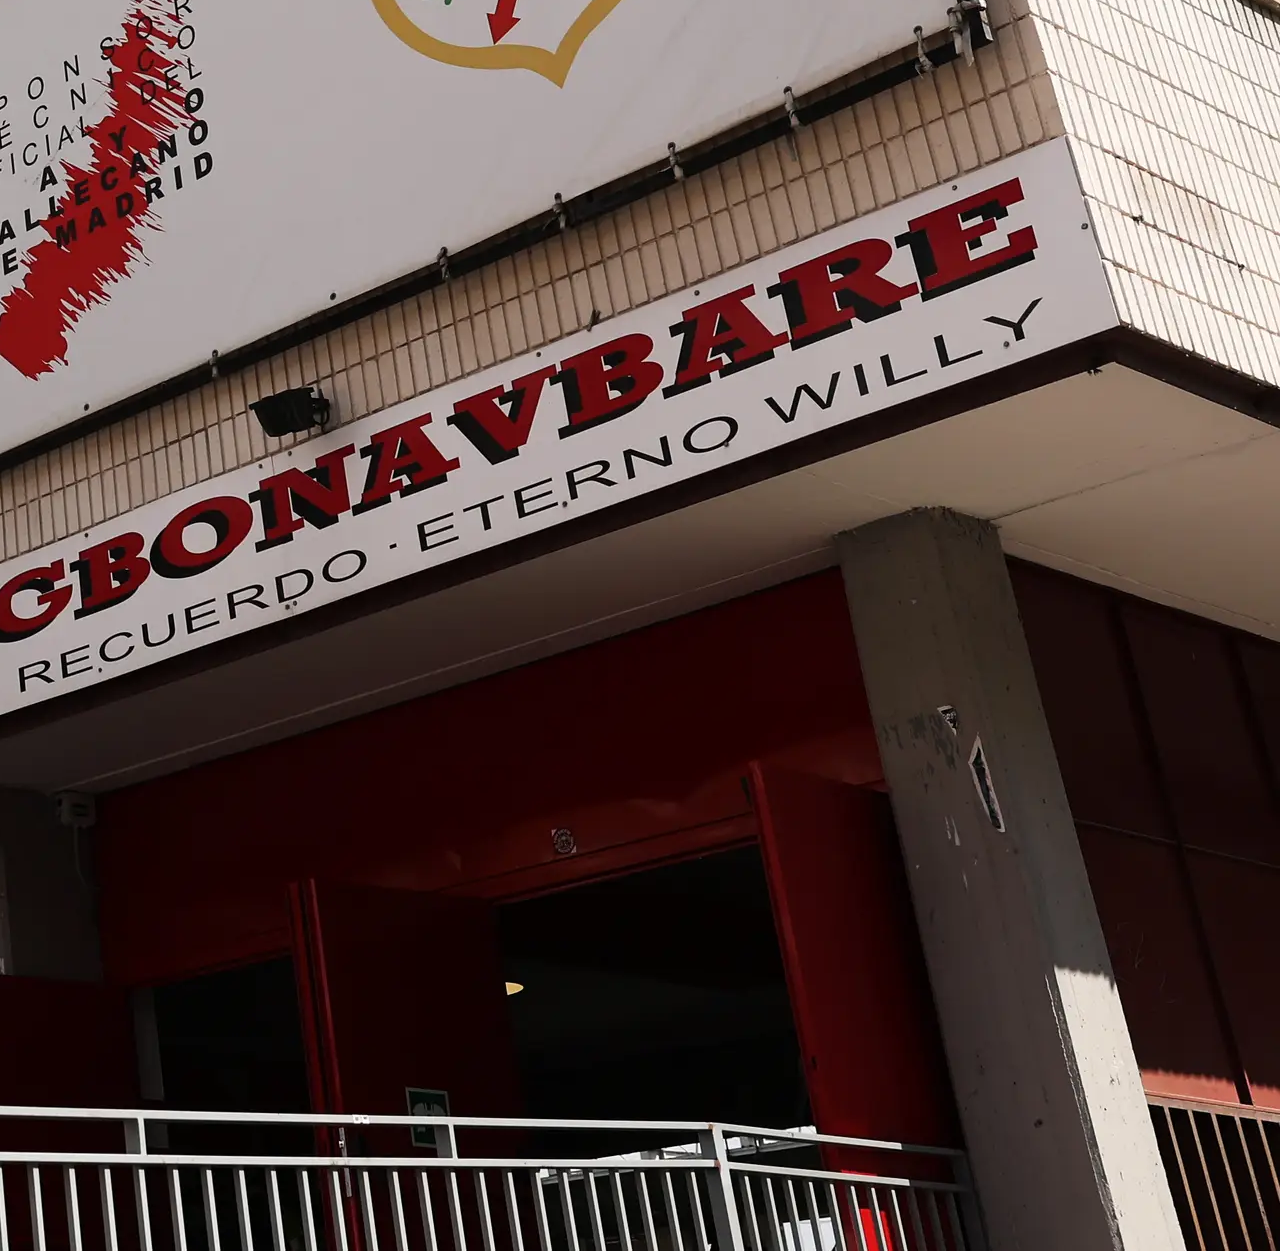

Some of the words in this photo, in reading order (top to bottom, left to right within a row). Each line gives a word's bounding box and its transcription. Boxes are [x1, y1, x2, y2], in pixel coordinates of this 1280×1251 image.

[140, 56, 203, 105] DEL
[55, 151, 214, 250] MADRID
[18, 549, 367, 692] RECUERDO
[416, 415, 739, 552] ETERNO
[764, 297, 1043, 423] WILLY
